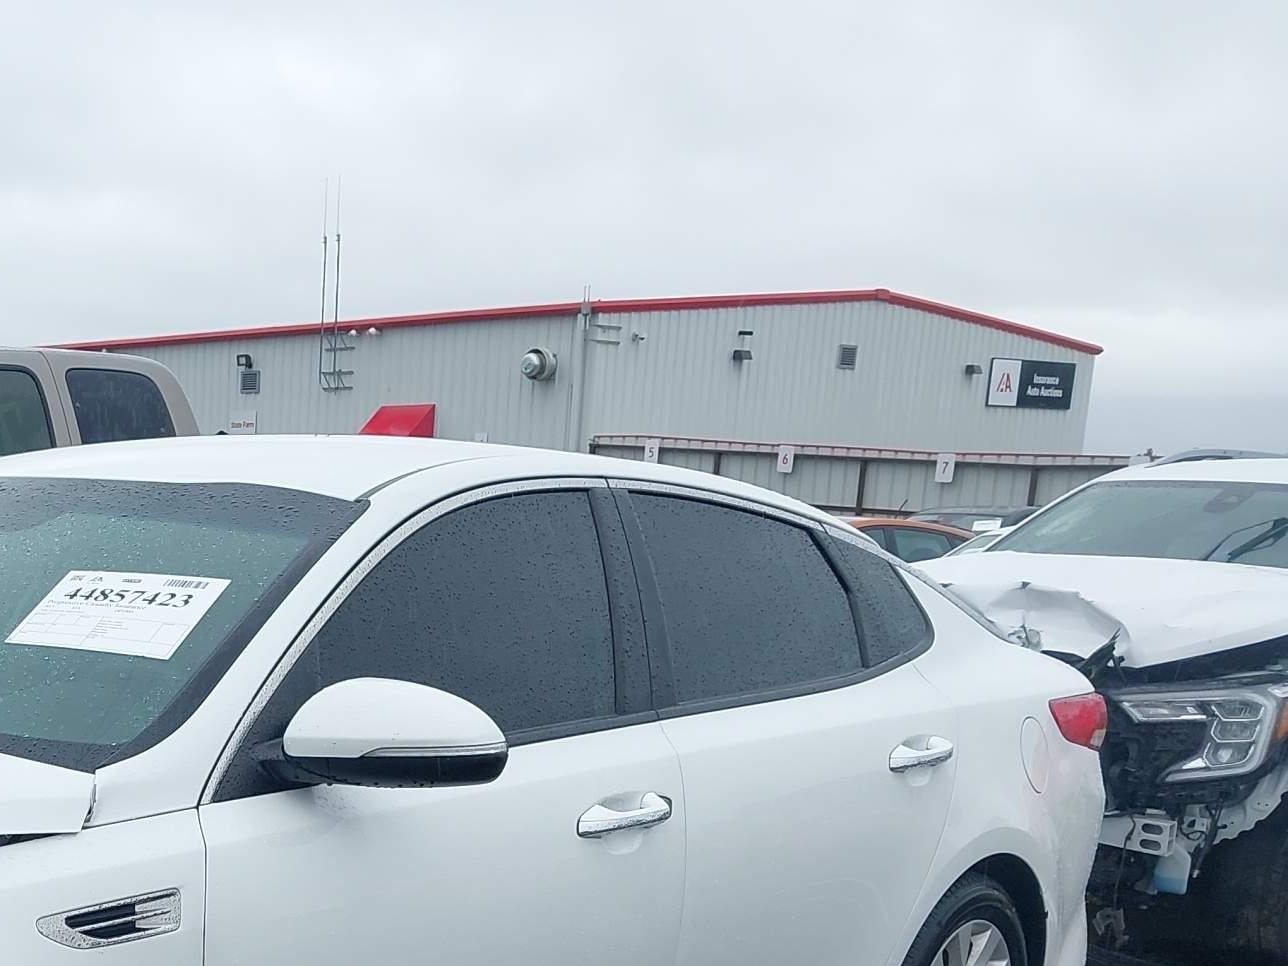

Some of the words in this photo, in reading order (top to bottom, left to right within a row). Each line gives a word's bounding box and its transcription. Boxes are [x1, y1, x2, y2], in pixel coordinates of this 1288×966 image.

[1033, 373, 1060, 385] Insurance
[1026, 385, 1039, 397] Auto
[1040, 386, 1063, 398] Auctions
[648, 446, 655, 458] 5
[782, 453, 789, 465] 6
[942, 461, 949, 475] 7
[64, 587, 194, 608] 44857423
